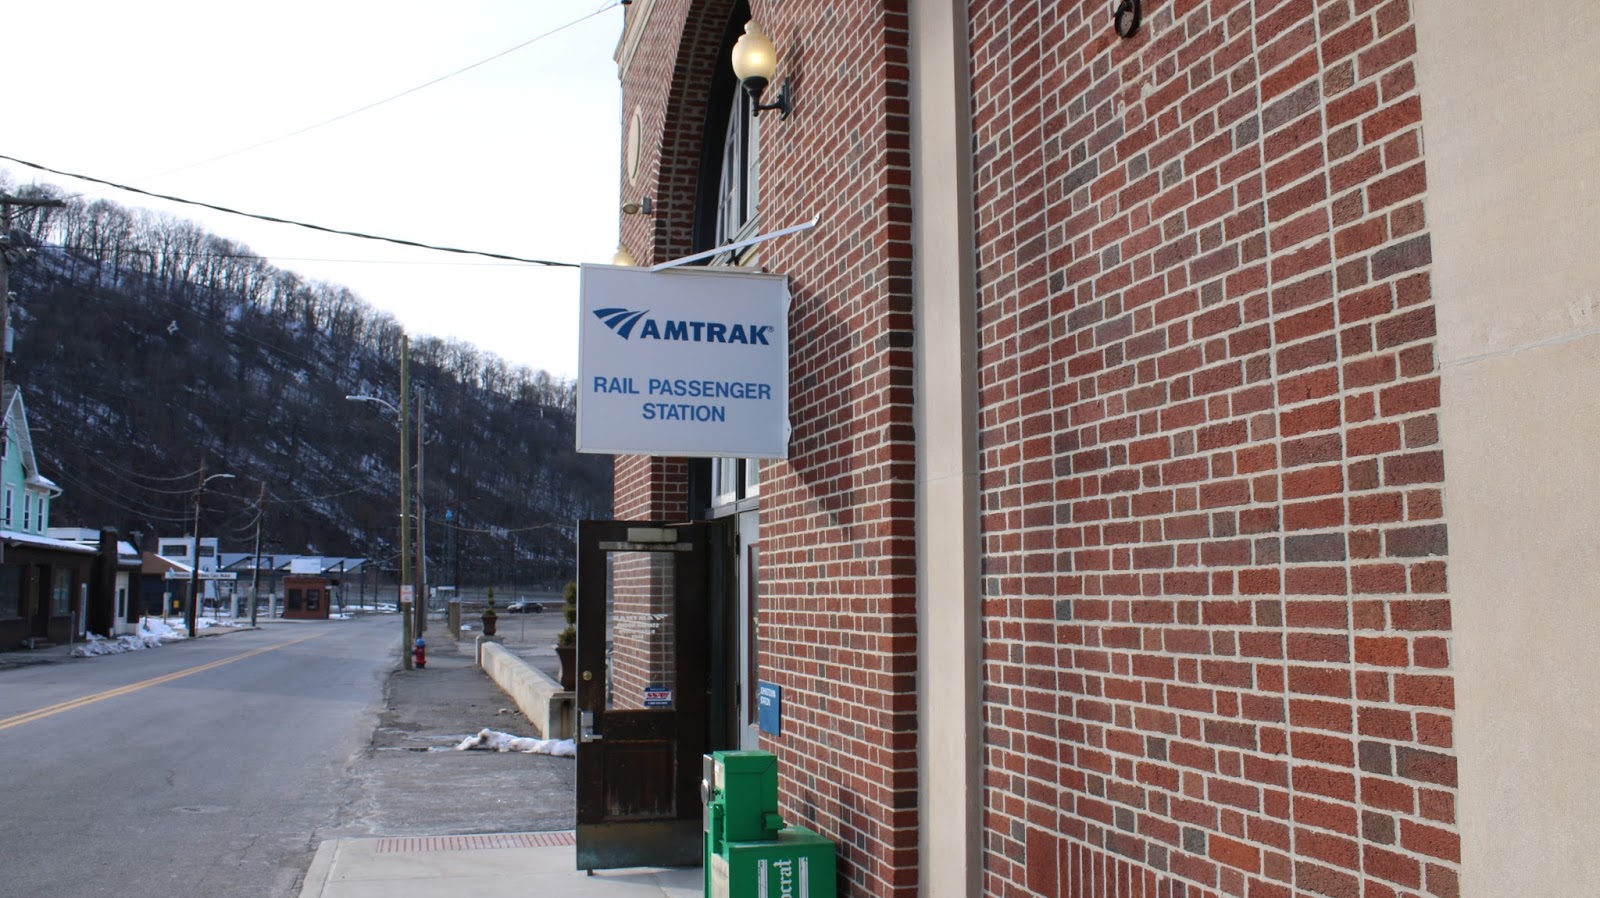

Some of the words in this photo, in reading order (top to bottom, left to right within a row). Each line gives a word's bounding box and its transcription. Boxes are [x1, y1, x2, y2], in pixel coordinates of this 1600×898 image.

[640, 319, 769, 345] AMTRAK
[594, 376, 639, 394] RAIL
[649, 379, 771, 399] PASSENGER
[642, 403, 725, 422] STATION
